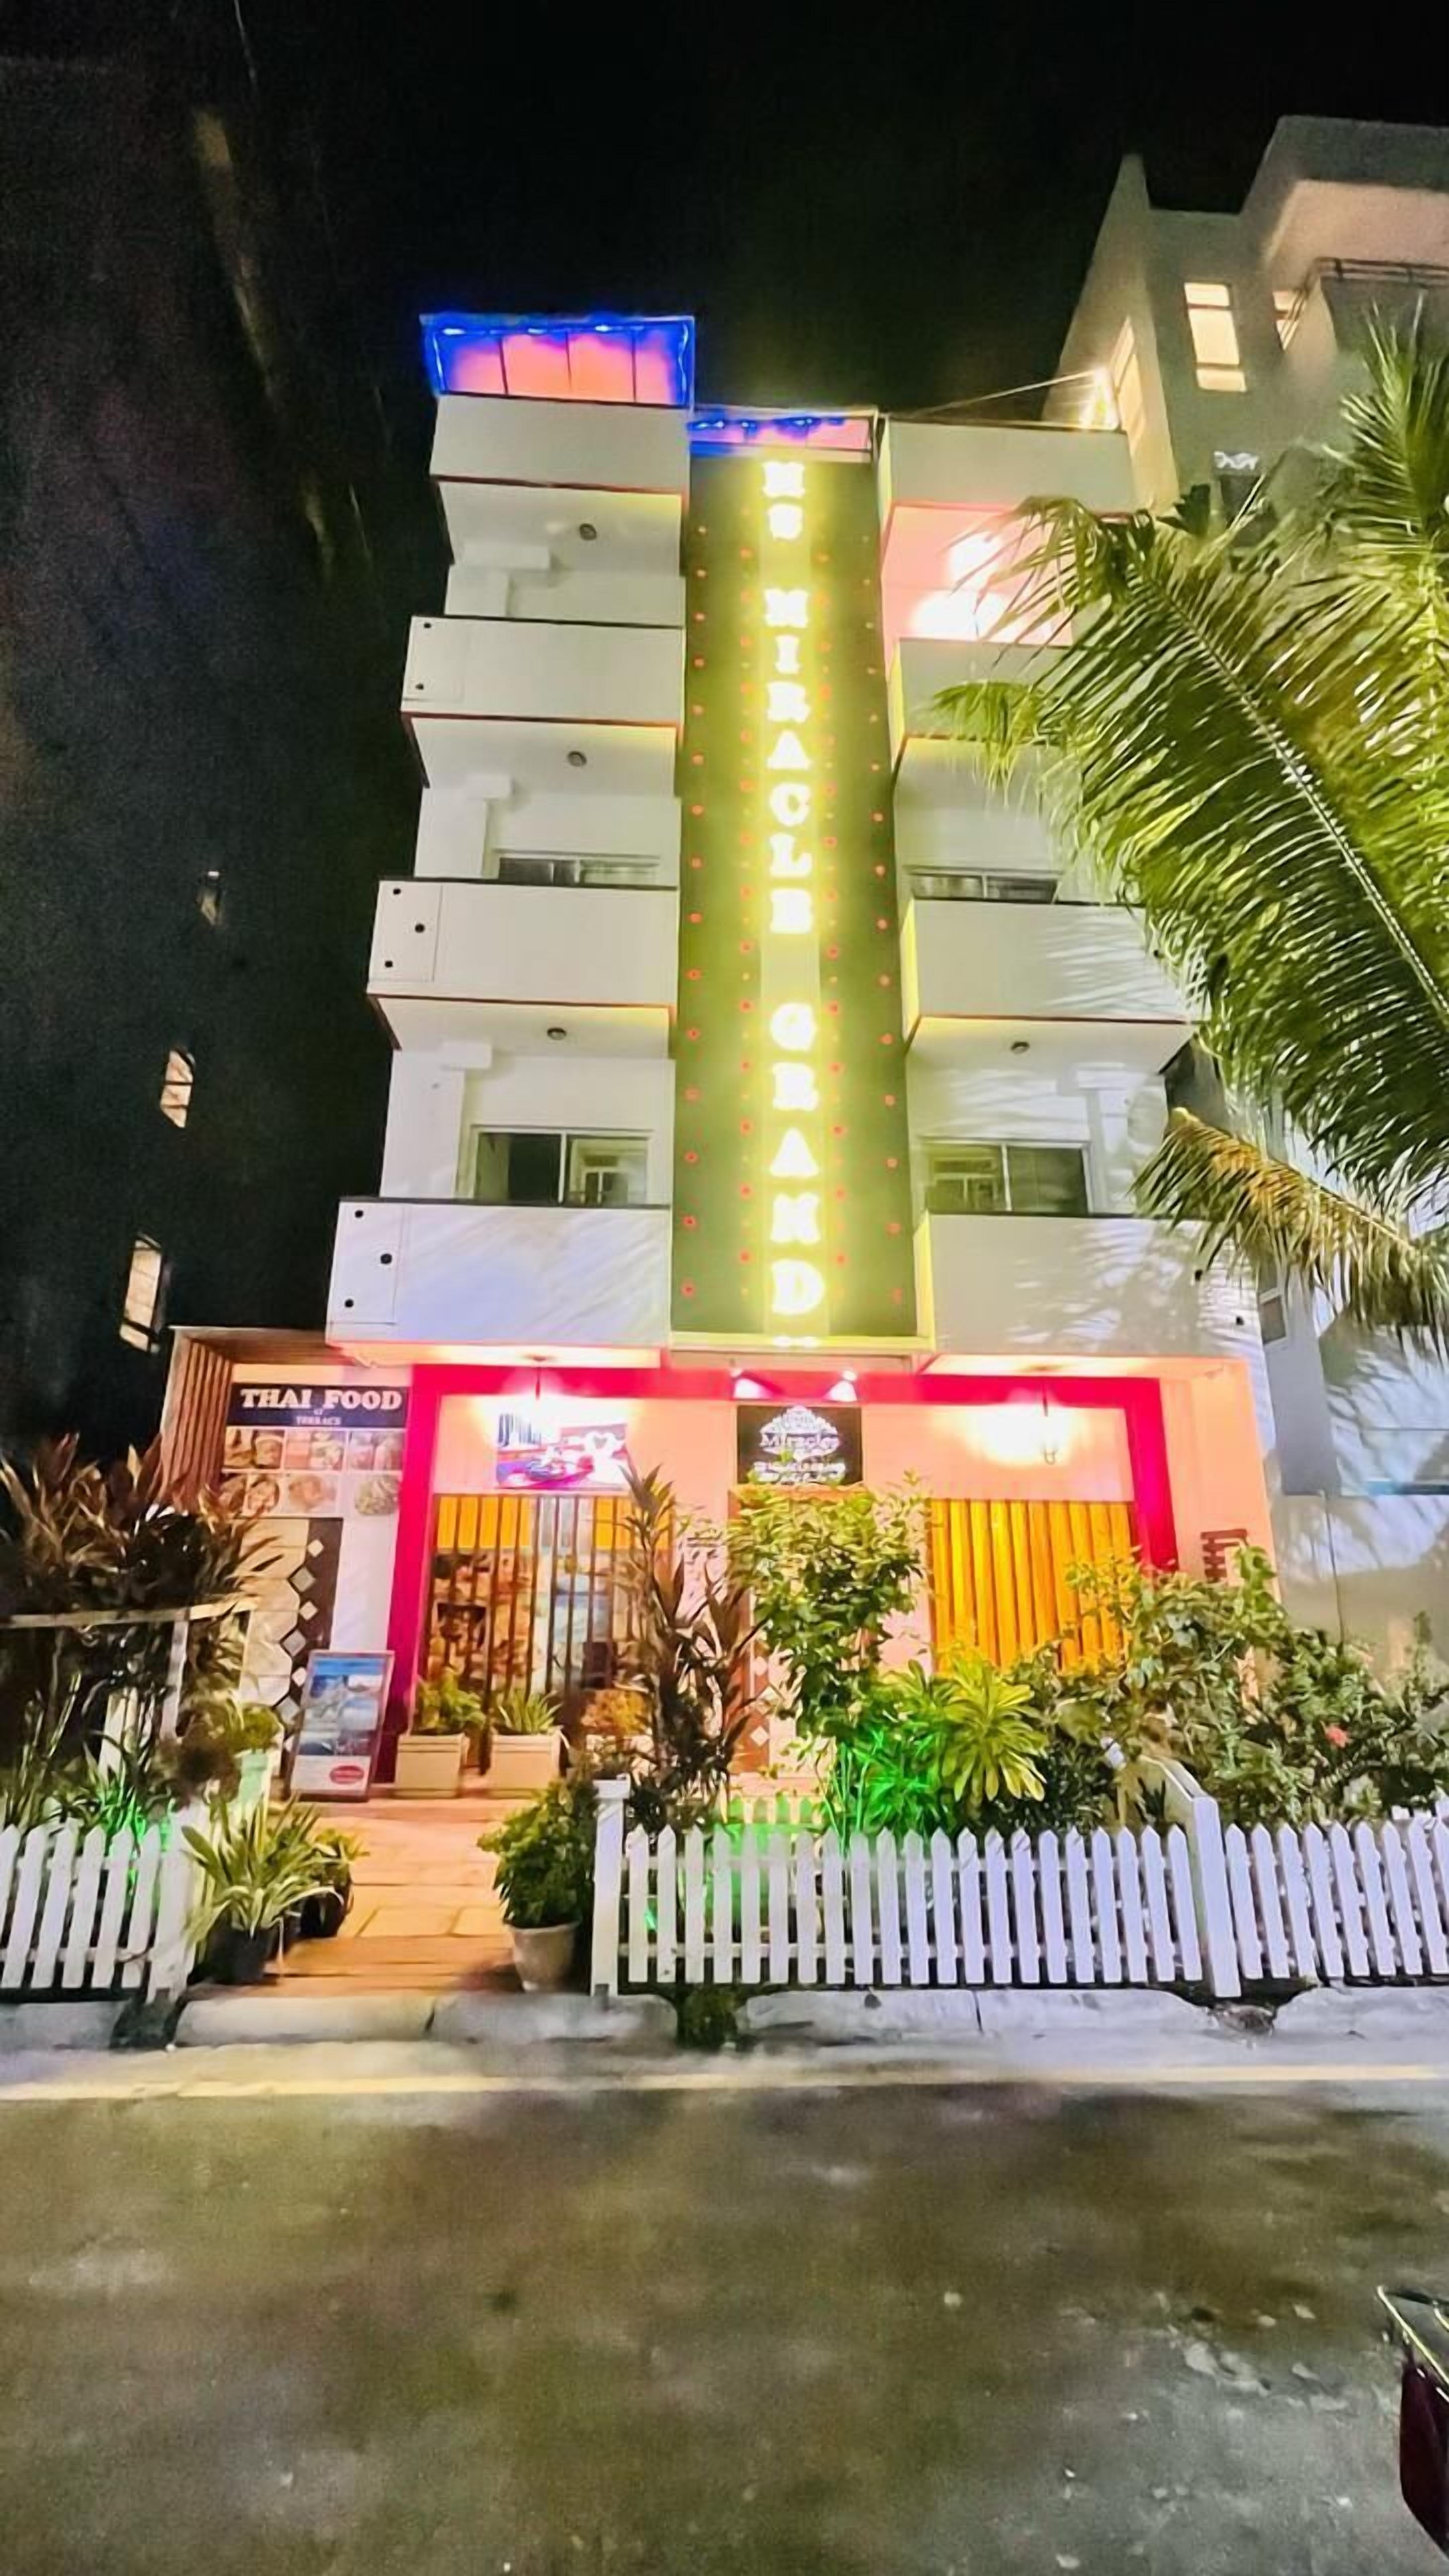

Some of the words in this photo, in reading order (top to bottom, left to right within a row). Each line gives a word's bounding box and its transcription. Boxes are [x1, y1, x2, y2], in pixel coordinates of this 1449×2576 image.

[764, 588, 812, 934] MIRACLE
[769, 1001, 824, 1316] GRAND
[240, 1389, 312, 1409] THAI
[321, 1389, 403, 1410] FOOD
